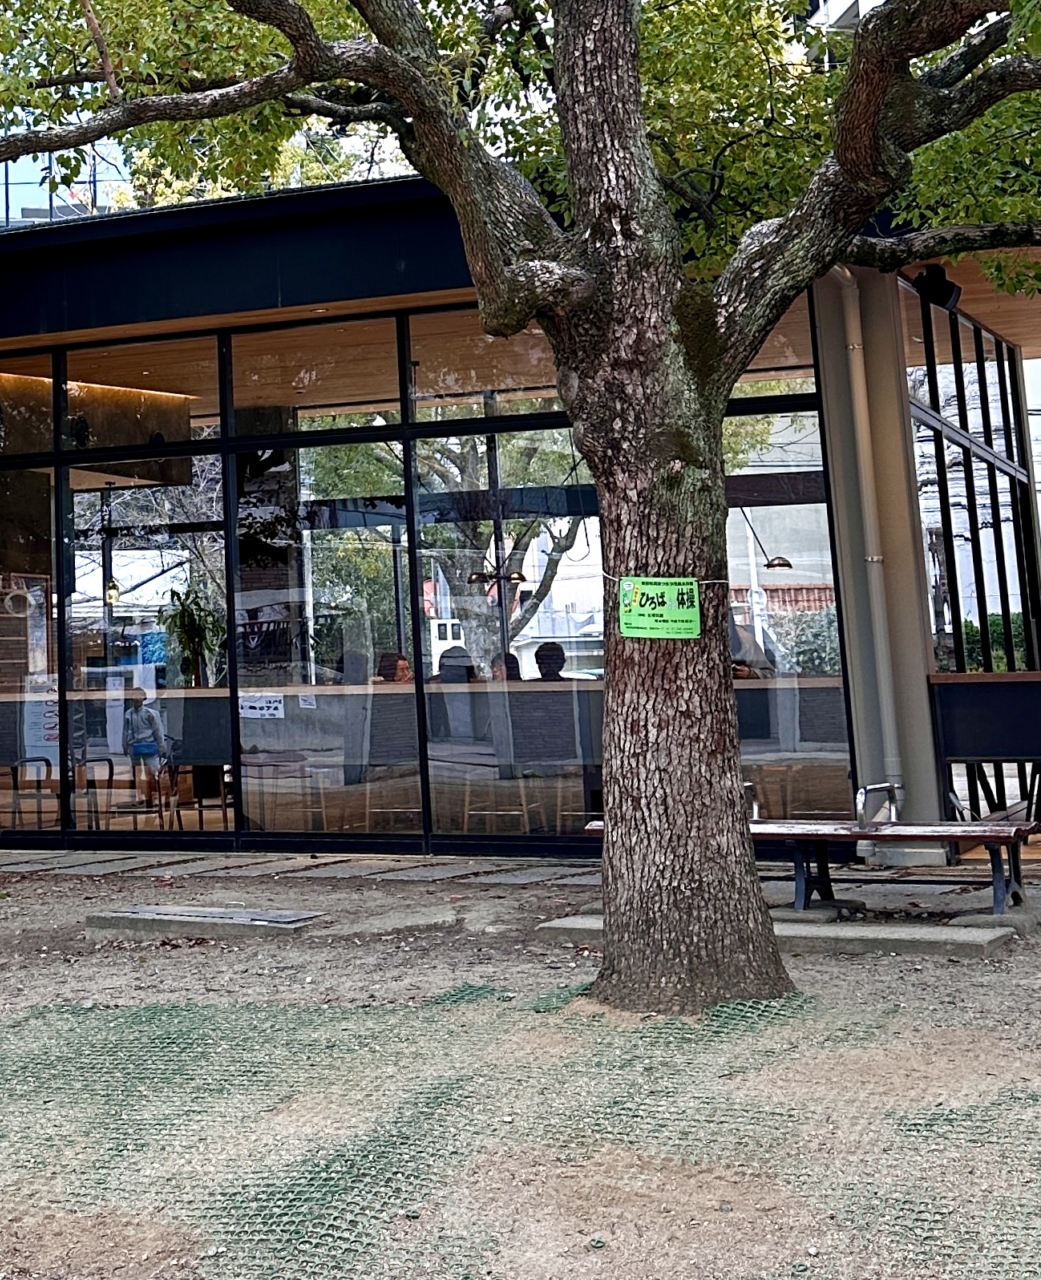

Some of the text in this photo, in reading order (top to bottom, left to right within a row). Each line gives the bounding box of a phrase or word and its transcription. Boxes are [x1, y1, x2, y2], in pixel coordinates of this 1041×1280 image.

[639, 591, 667, 610] ひろば
[677, 588, 696, 609] 体操
